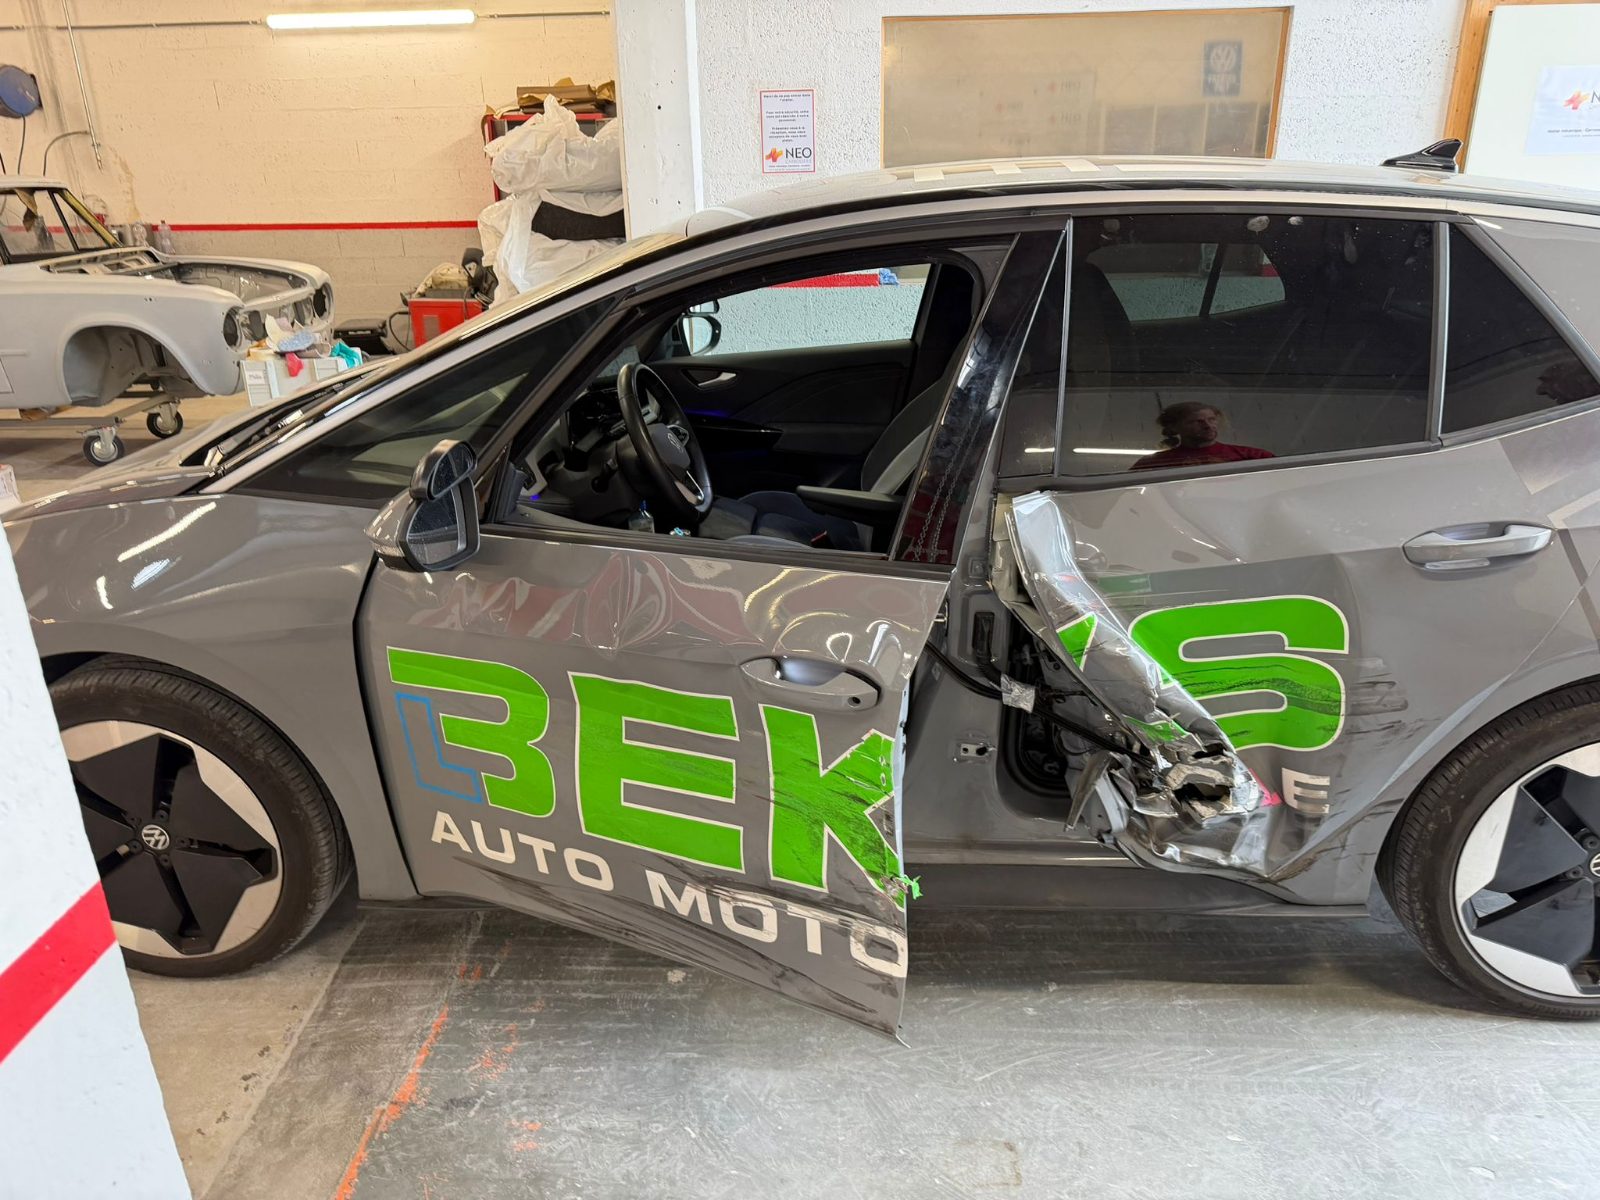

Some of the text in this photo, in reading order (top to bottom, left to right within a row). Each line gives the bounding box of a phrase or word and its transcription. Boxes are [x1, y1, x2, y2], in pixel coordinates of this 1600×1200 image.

[785, 147, 812, 159] NEO
[387, 594, 1349, 911] BEK S
[431, 810, 614, 891] AUTO
[645, 869, 907, 978] MOTO
